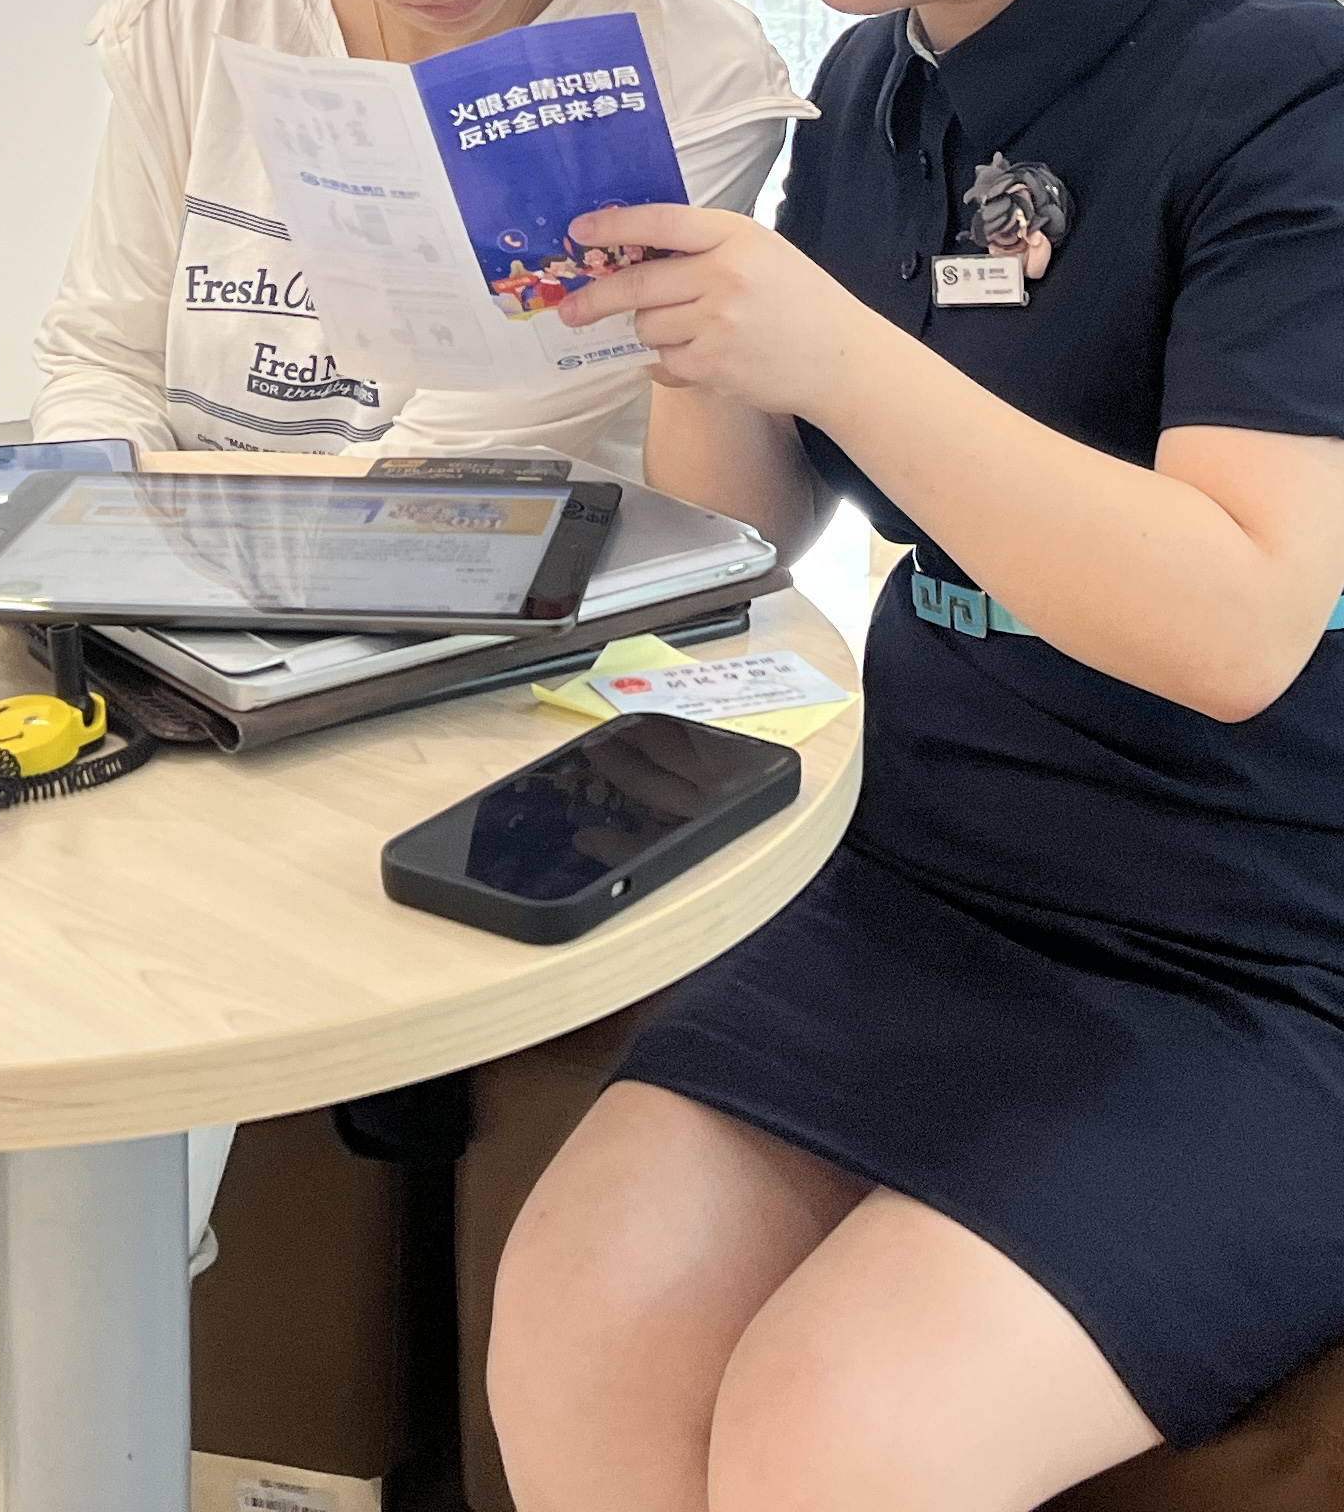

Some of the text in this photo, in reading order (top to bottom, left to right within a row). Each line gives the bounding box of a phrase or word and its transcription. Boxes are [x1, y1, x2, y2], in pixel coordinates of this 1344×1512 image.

[449, 65, 640, 127] 火眼金睛识骗局
[459, 92, 646, 150] 反诈全民来参与
[185, 265, 279, 307] Fresh
[250, 342, 318, 383] Fred
[251, 379, 279, 395] FOR
